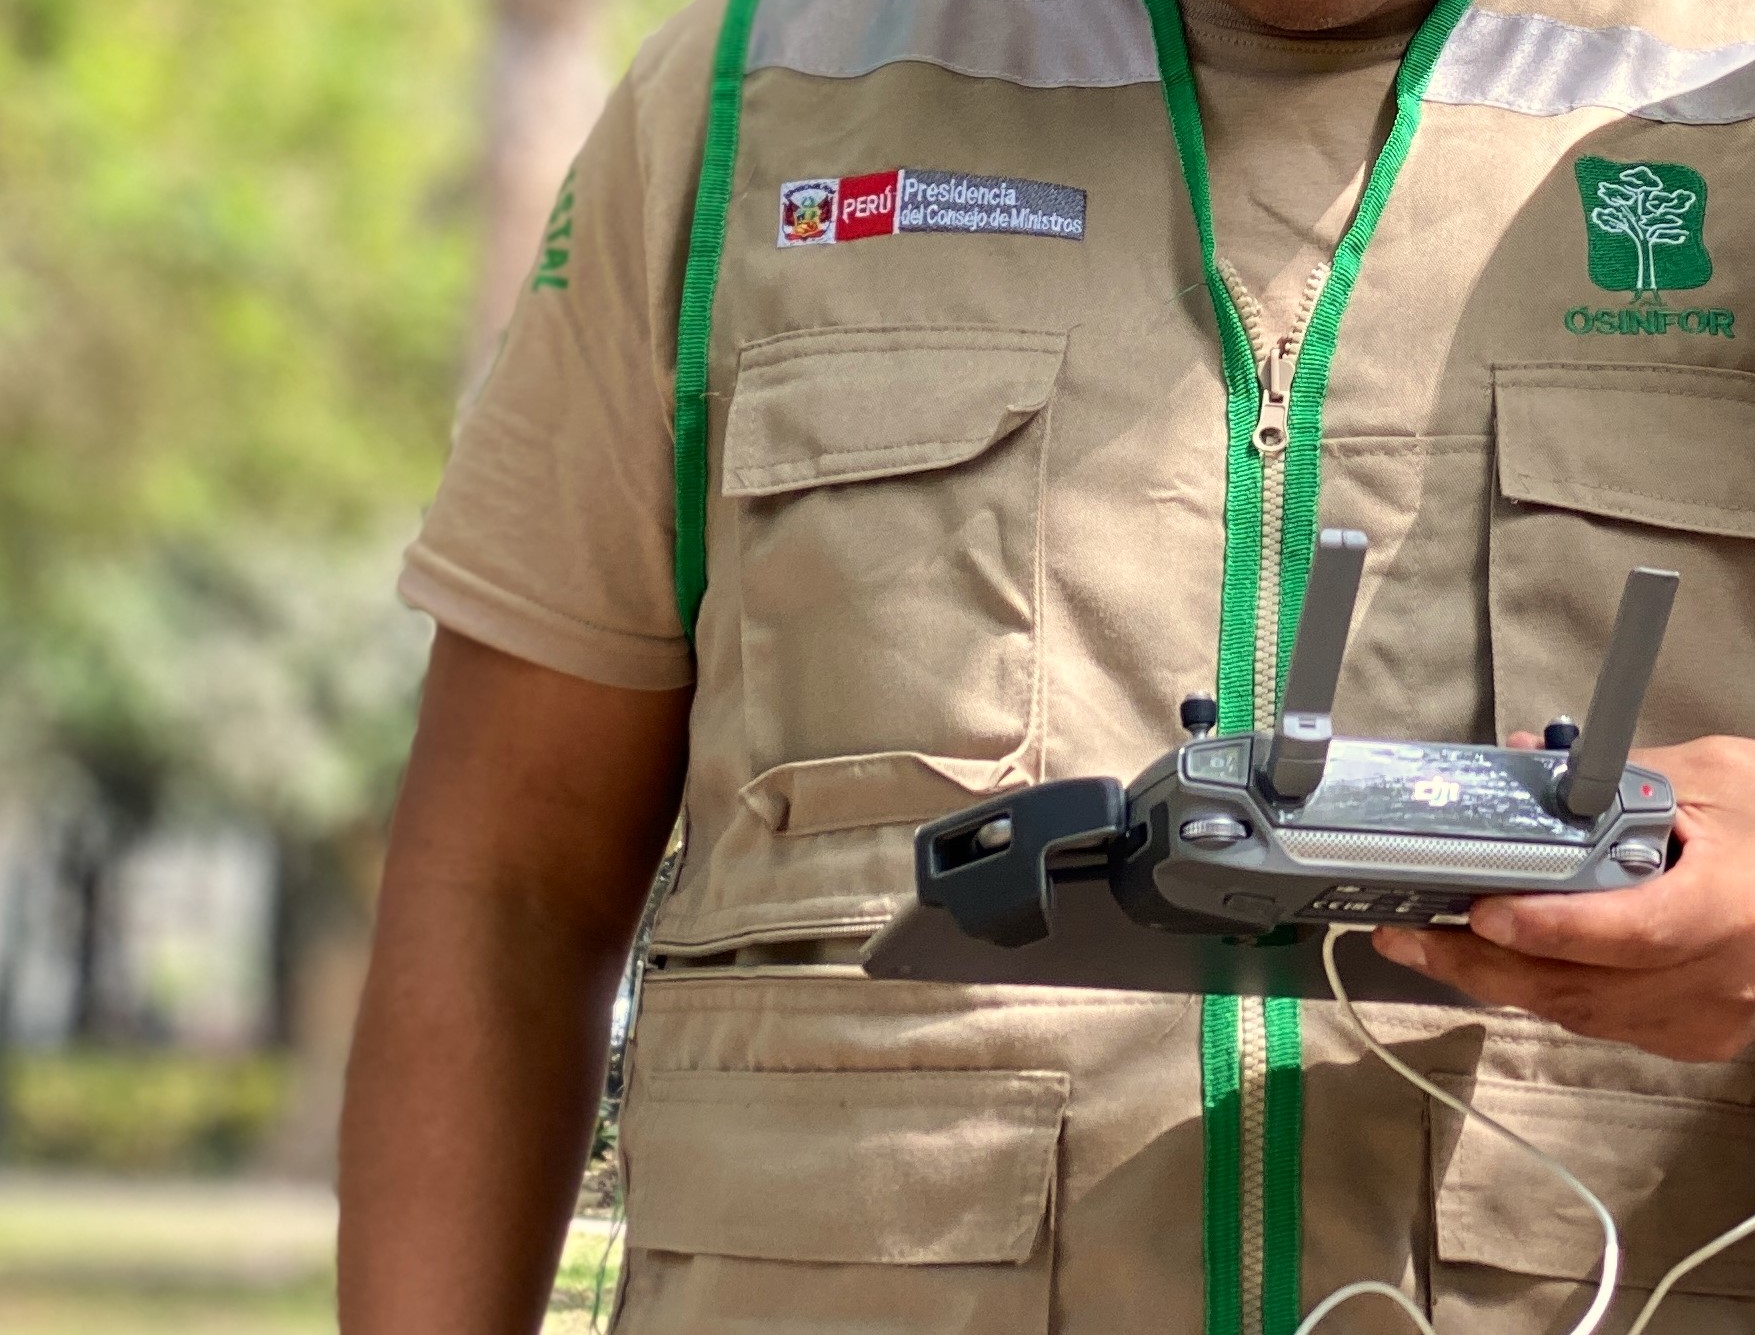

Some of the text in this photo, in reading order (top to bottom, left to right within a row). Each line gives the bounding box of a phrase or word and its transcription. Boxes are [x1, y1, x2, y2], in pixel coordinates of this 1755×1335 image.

[841, 184, 893, 225] PERÚ
[903, 177, 1018, 207] Presidencia
[901, 203, 1084, 234] del Consejo de Ministros
[1563, 305, 1737, 340] OSINFOR
